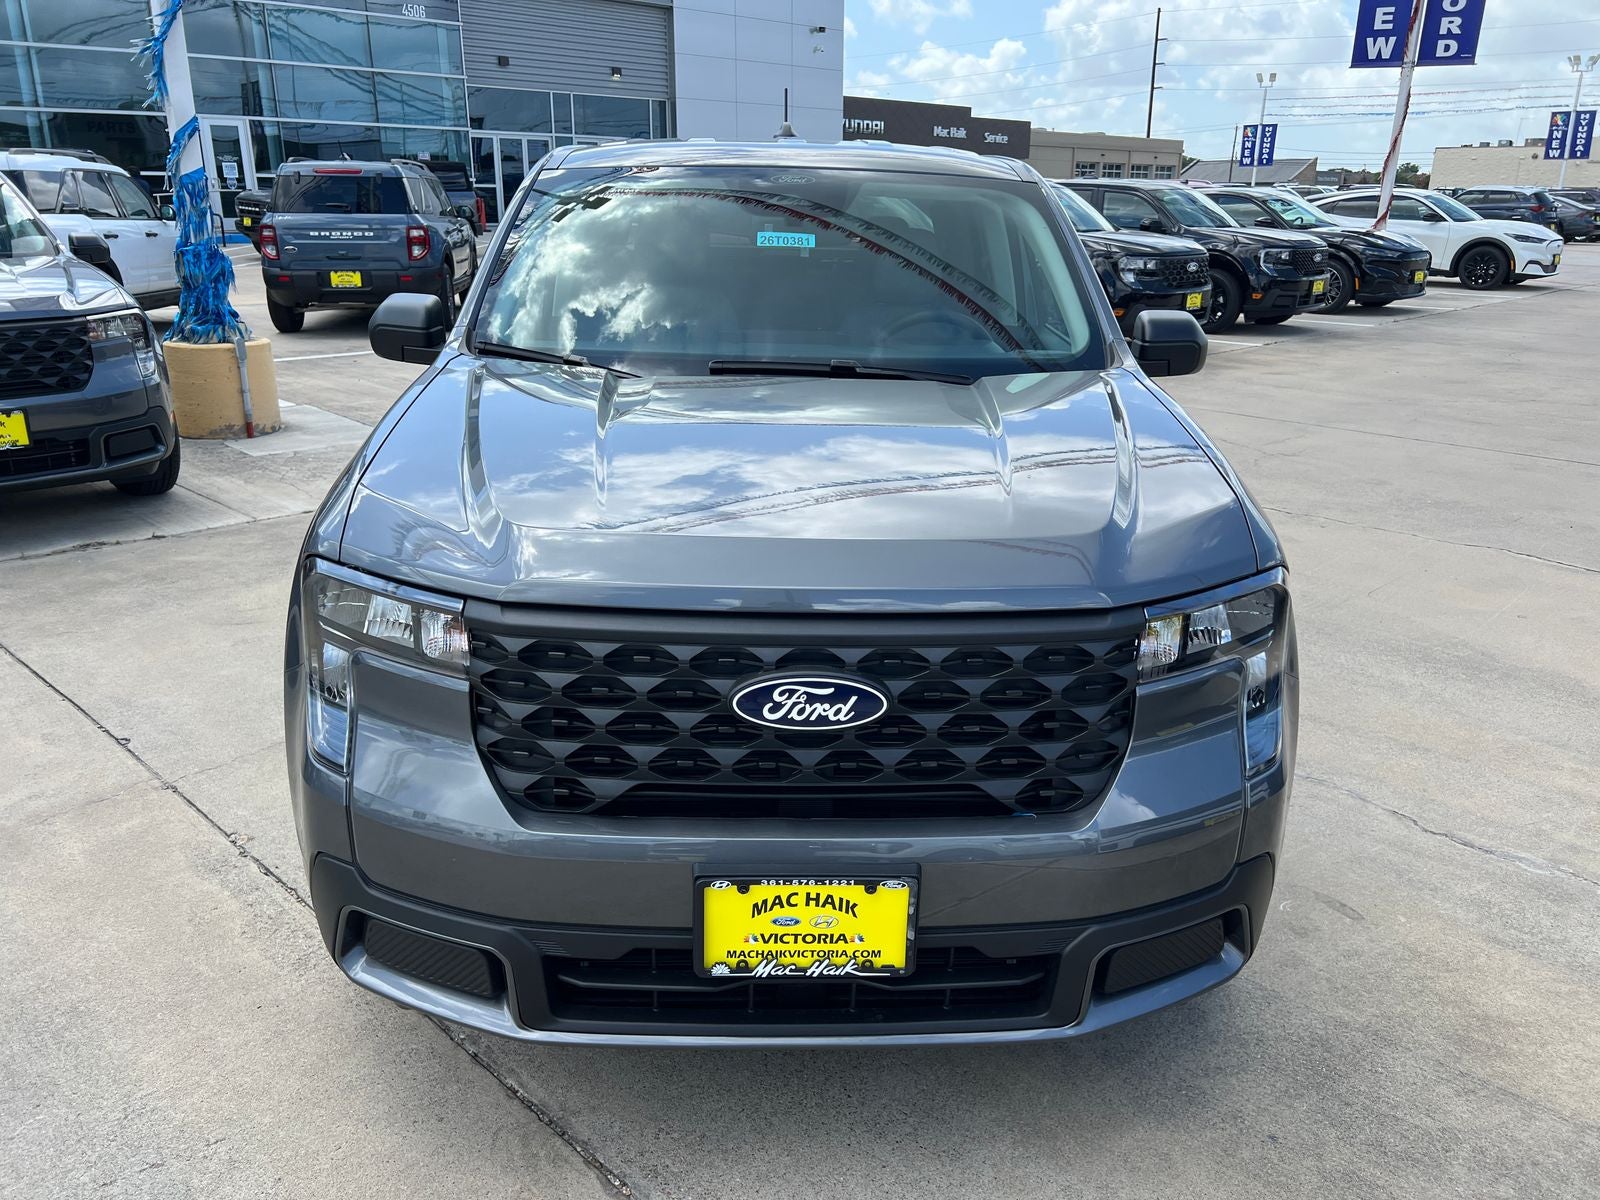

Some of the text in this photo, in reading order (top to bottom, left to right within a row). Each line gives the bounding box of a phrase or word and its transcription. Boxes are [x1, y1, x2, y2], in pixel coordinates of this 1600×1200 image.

[402, 3, 426, 18] 4506
[88, 121, 136, 134] PARTS
[933, 125, 967, 140] Mac Haik
[1574, 113, 1590, 157] HYUNDAI
[984, 132, 1009, 144] Service
[1261, 126, 1273, 164] HYUNDAI
[1548, 130, 1563, 158] NEW
[1242, 140, 1252, 165] NEW
[777, 174, 809, 184] Ford
[760, 235, 811, 247] 26T0381
[762, 684, 859, 722] Ford
[760, 879, 855, 887] 361-576-1221
[884, 881, 903, 889] Ford
[751, 891, 859, 919] MAC HAIK
[759, 932, 849, 945] VICTORIA
[726, 949, 882, 959] MACHAIKVICTORIA.COM
[751, 958, 868, 978] Mac Haik
